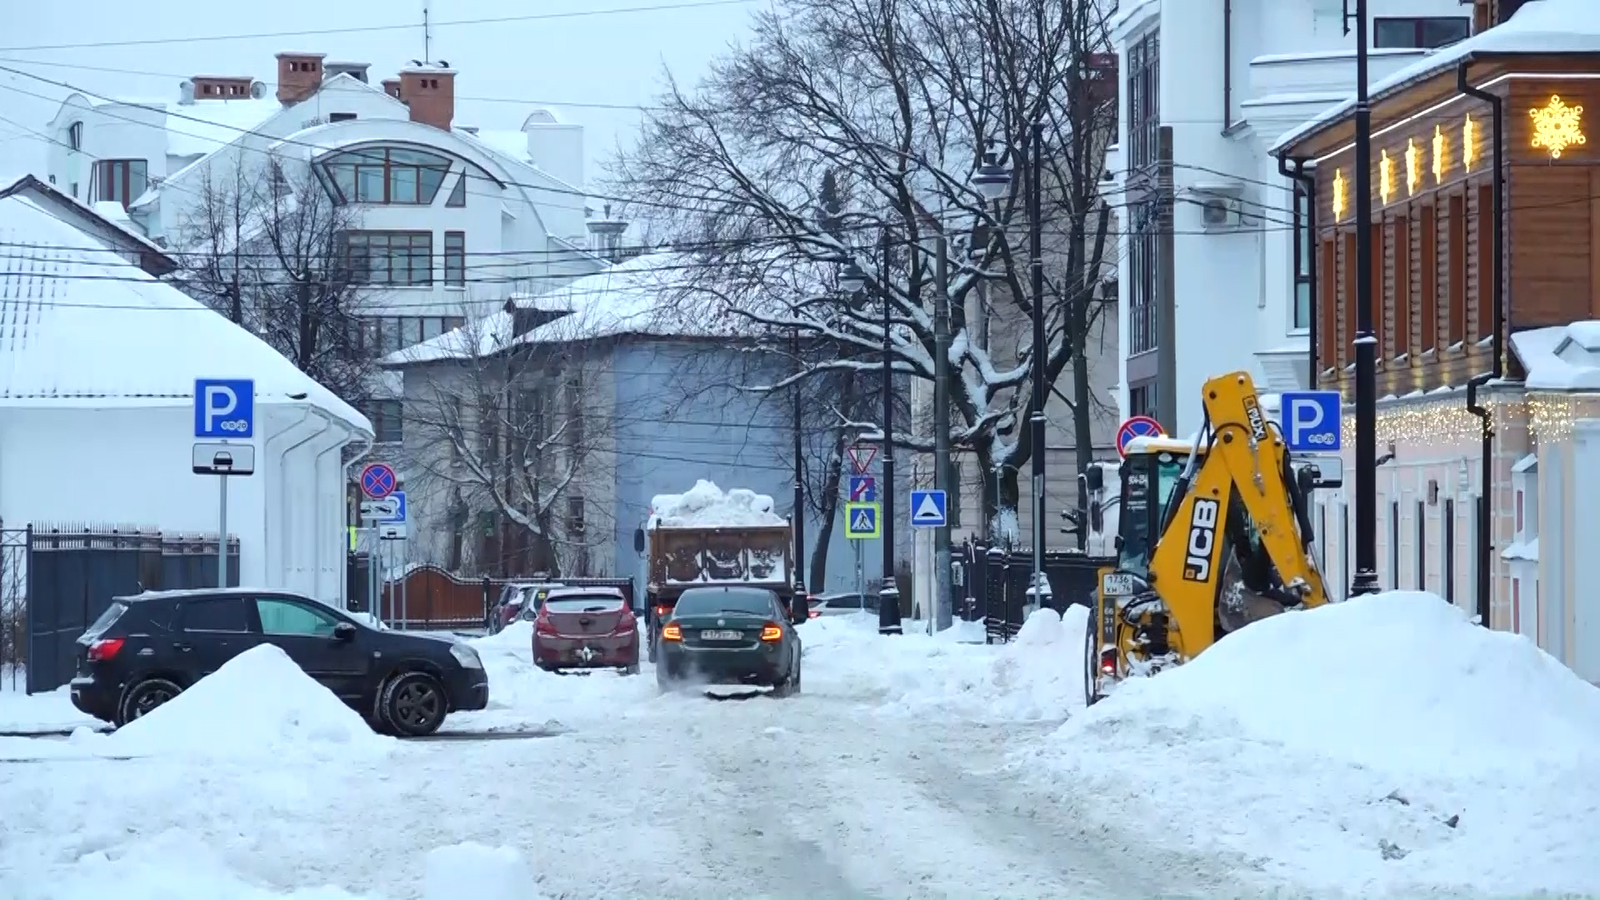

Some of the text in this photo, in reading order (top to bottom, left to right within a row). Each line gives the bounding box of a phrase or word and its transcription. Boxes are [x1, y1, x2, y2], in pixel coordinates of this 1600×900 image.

[205, 386, 237, 432] P
[1292, 399, 1324, 445] P
[1187, 500, 1217, 581] JCB
